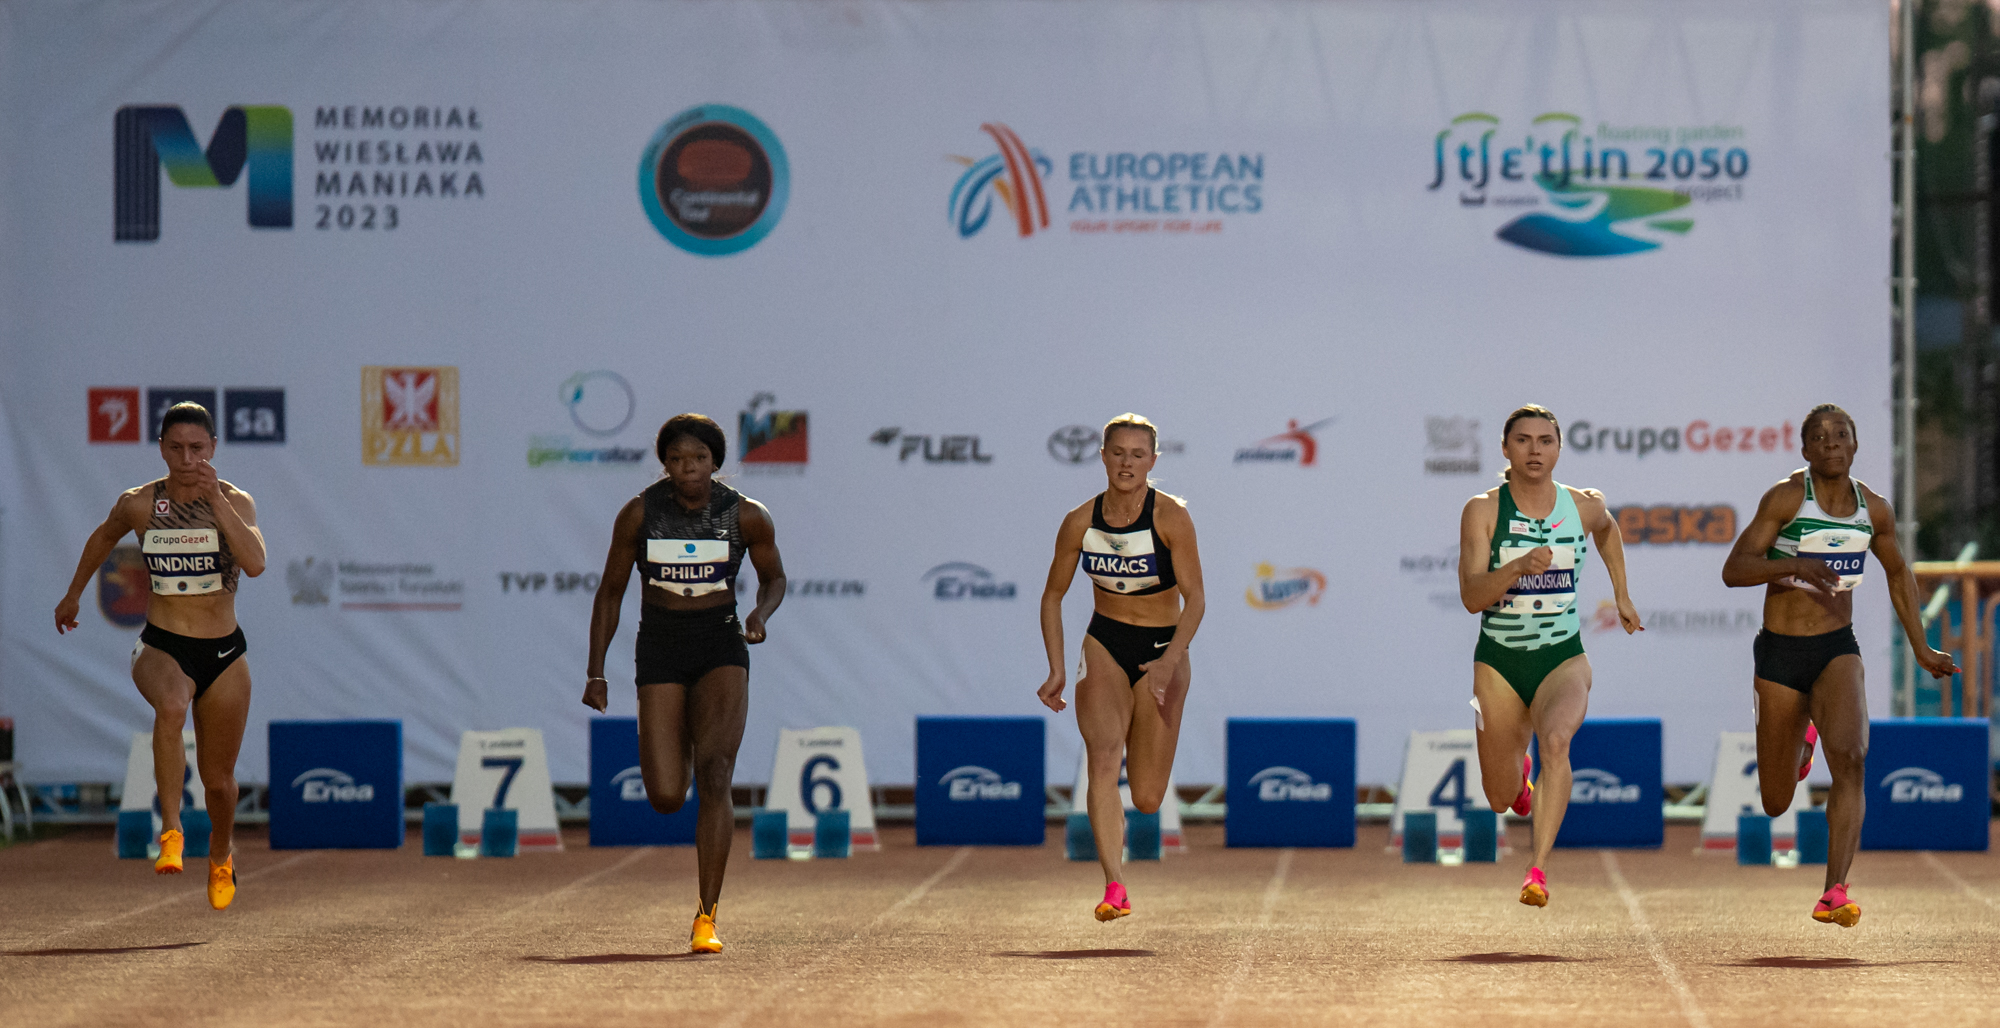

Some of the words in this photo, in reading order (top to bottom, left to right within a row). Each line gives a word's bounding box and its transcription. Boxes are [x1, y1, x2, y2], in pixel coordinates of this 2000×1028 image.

[315, 106, 482, 130] MEMORIAŁ
[315, 141, 483, 165] WIESŁAWA
[1645, 147, 1749, 180] 2050
[1068, 153, 1264, 182] EUROPEAN
[315, 171, 483, 197] MANIAKA
[1674, 184, 1743, 204] project
[1068, 184, 1263, 214] ATHLETICS
[315, 204, 399, 230] 2023
[233, 406, 276, 437] sa
[1567, 420, 1794, 458] GrupaGezet
[152, 534, 209, 547] GrupaGezet
[147, 556, 216, 572] LINDNER
[661, 565, 715, 580] PHILIP
[1088, 556, 1149, 574] TAKÁCS
[501, 572, 547, 593] TVP
[554, 572, 600, 593] SPO
[1512, 572, 1572, 591] MANOUSKAYA
[302, 780, 374, 802] Enea
[480, 756, 525, 809] 7
[799, 753, 842, 816] 6
[949, 778, 1022, 800] Enea
[1258, 779, 1332, 801] Enea
[1428, 756, 1474, 819] 4
[1890, 779, 1963, 802] Enea
